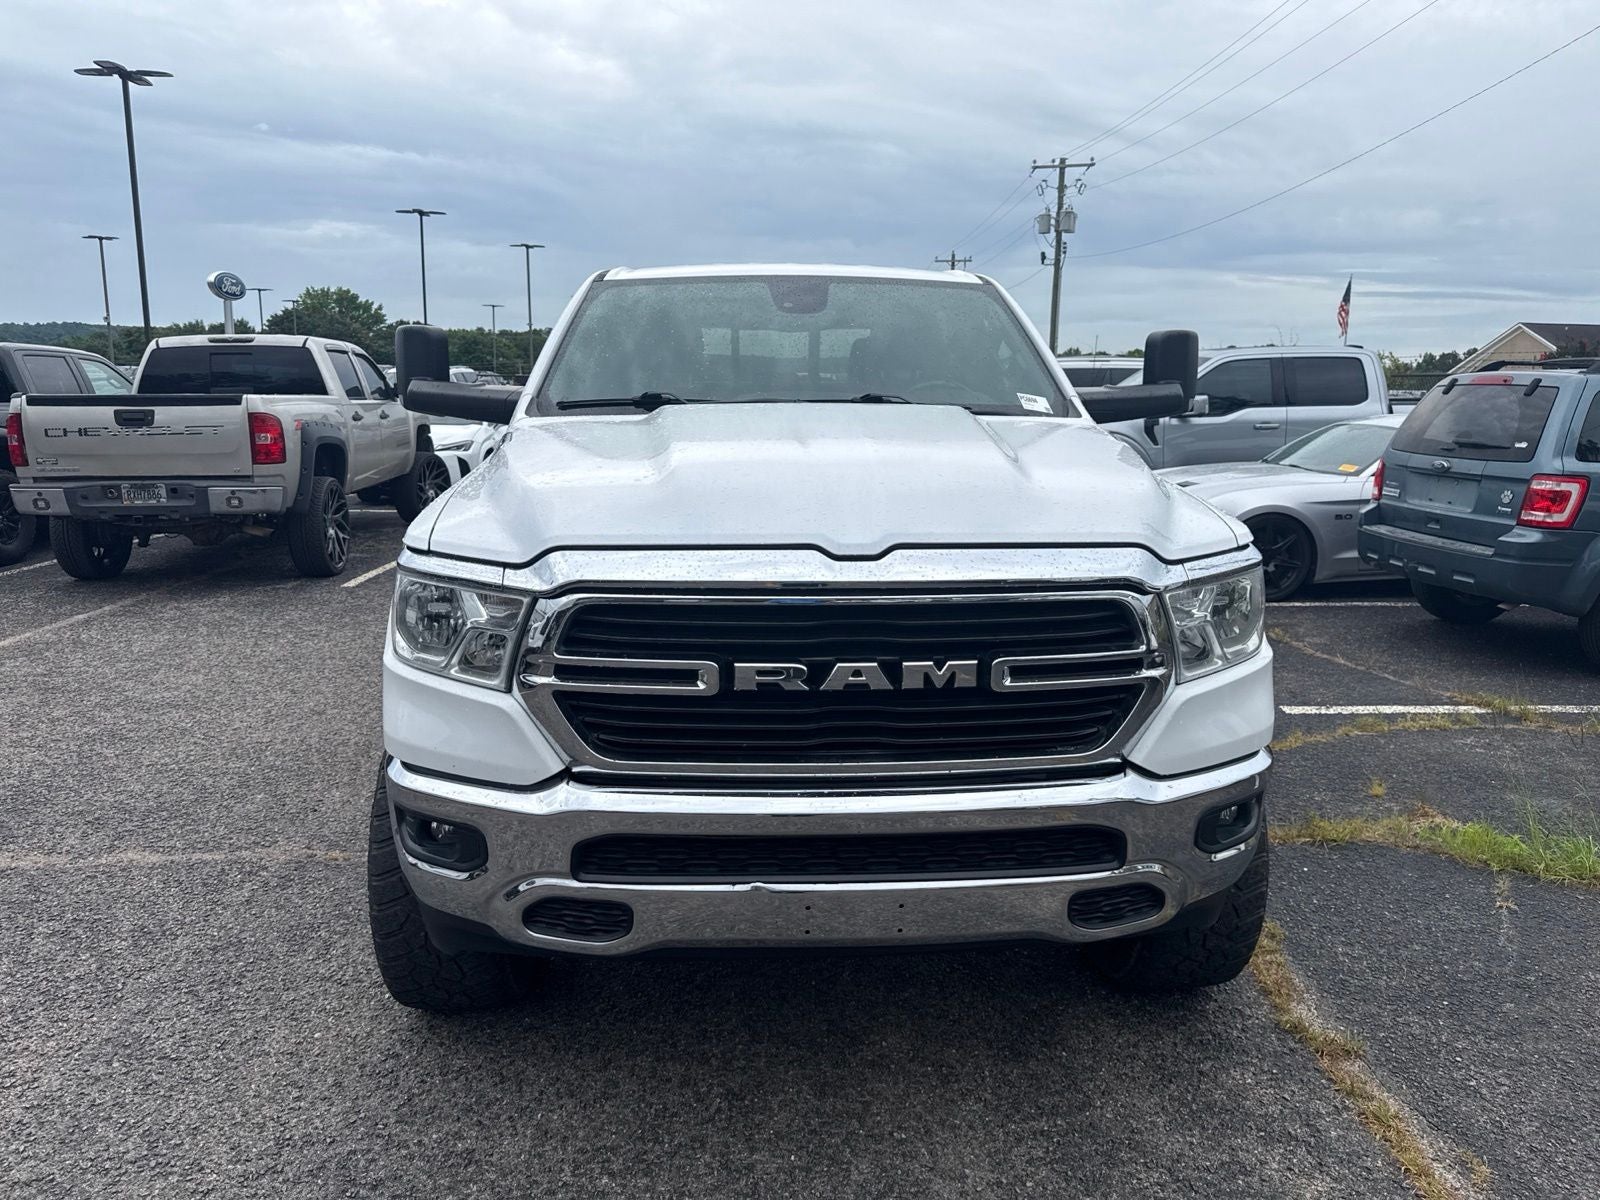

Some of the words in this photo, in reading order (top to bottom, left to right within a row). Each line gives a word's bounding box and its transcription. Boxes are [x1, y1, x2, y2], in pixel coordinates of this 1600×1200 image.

[222, 277, 242, 295] Ford
[43, 424, 225, 438] CHEVROLET
[733, 660, 979, 691] RAM
